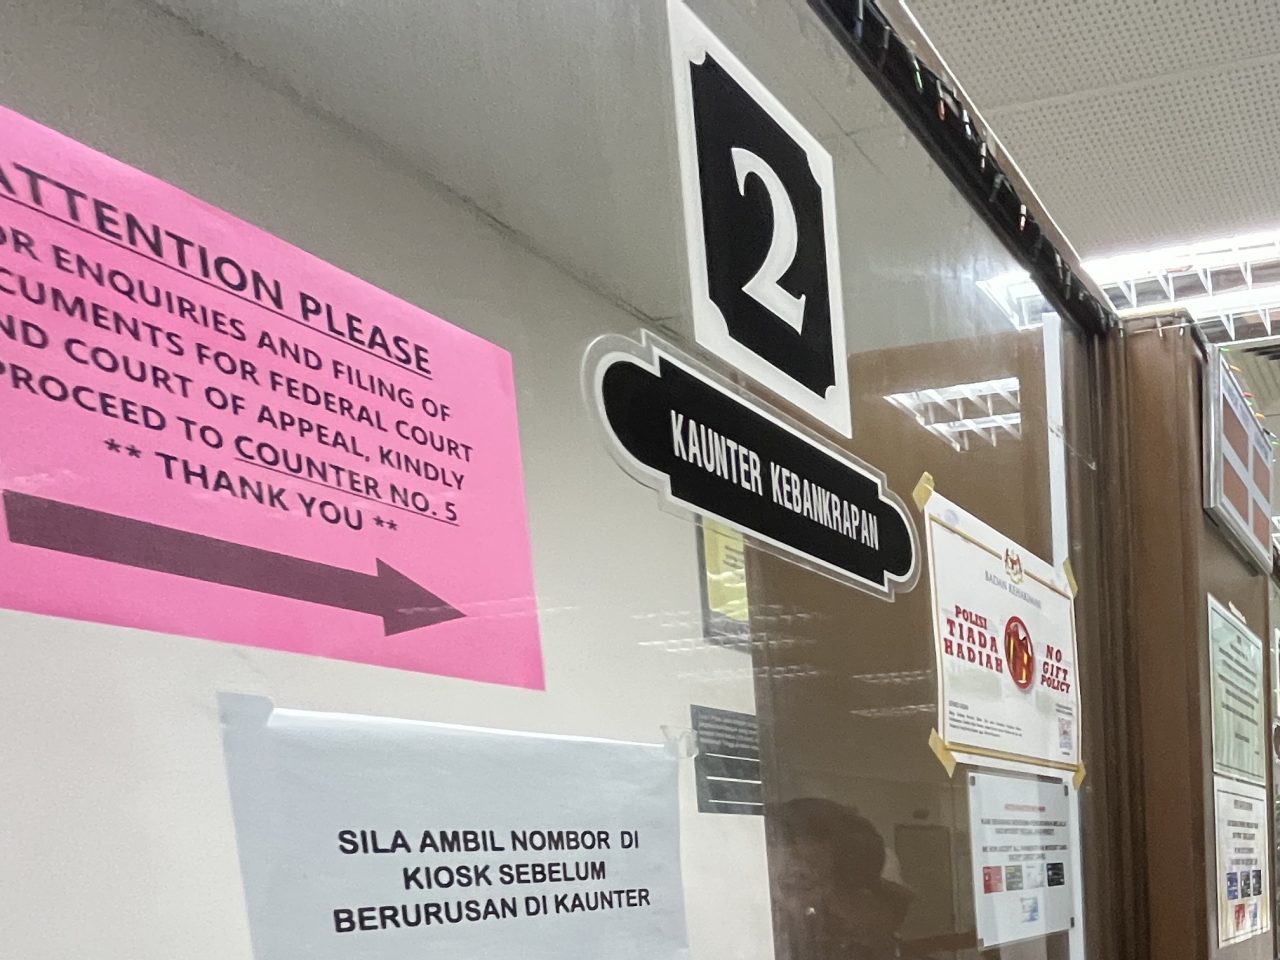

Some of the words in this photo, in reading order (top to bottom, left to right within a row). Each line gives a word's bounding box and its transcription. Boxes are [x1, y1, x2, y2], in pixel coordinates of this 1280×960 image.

[731, 147, 806, 335] 2
[52, 244, 246, 342] ENQUIRIES
[257, 331, 323, 370] AND
[332, 359, 414, 408] FILING
[421, 398, 451, 422] OF
[300, 291, 432, 375] PLEASE
[64, 338, 193, 398] COURT
[205, 386, 246, 416] OF
[379, 445, 464, 490] KINDLY
[196, 343, 260, 385] FOR
[269, 370, 388, 432] FEDERAL
[395, 420, 473, 463] COURT
[0, 361, 167, 431] ROCEED
[176, 415, 223, 449] TO
[234, 435, 382, 499] COUNTER
[390, 484, 437, 517] NO.
[445, 502, 458, 522] 5
[155, 451, 289, 511] THANK
[297, 493, 363, 531] YOU
[670, 409, 763, 496] KAUNTER
[770, 461, 879, 552] KEBANKRAPAN
[947, 618, 999, 653] TIADA
[954, 604, 988, 630] POLISI
[943, 637, 1004, 674] HADIAH
[1042, 660, 1068, 681] GIFT
[1045, 644, 1063, 663] NO
[1040, 675, 1070, 694] POLICY
[338, 830, 411, 855] SILA
[419, 829, 505, 854] AMBIL
[511, 829, 611, 852] NOMBOR
[620, 830, 639, 850] DI
[402, 865, 492, 891] KIOSK
[499, 861, 606, 884] SEBELUM
[333, 896, 517, 933] BERURUSAN
[524, 895, 548, 917] DI
[554, 888, 651, 915] KAUNTER
